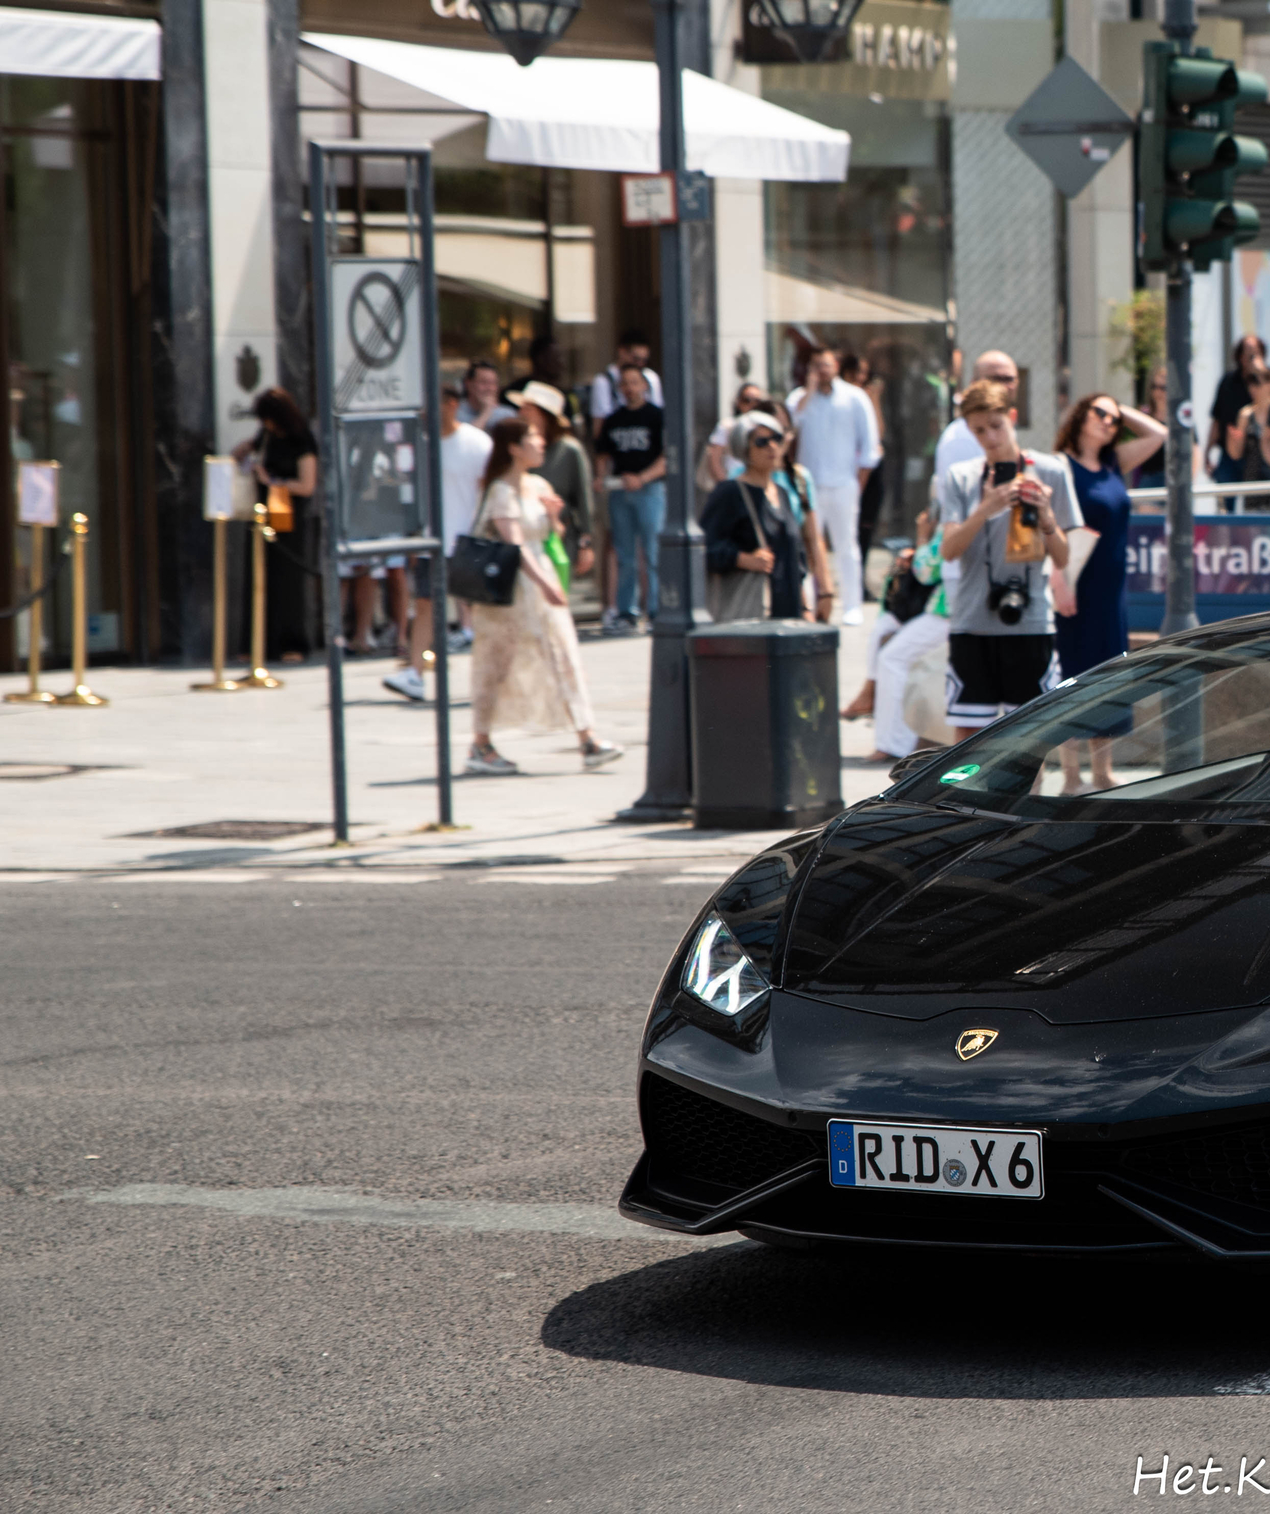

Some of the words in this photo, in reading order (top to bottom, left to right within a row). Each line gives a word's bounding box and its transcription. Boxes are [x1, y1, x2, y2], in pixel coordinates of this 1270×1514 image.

[356, 376, 403, 402] ZONE
[838, 1160, 848, 1174] D
[858, 1132, 940, 1184] RID
